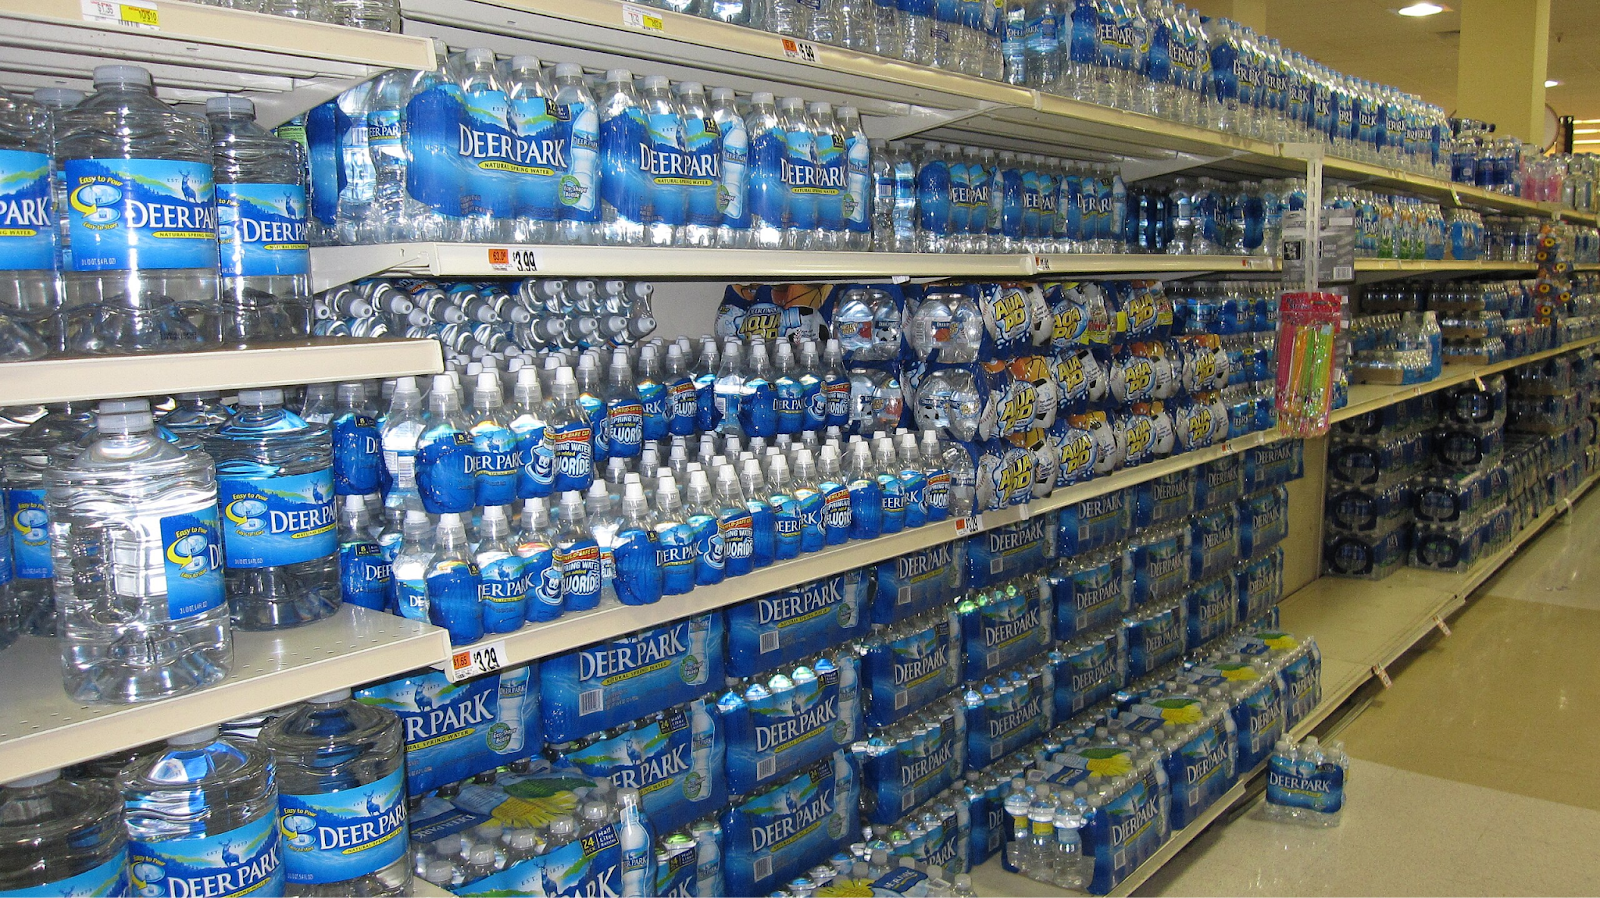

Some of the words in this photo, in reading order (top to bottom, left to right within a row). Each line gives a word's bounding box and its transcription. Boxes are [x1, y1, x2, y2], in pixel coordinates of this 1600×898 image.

[459, 123, 516, 163] DEER
[516, 140, 568, 172] PARK
[640, 142, 685, 179] DEER
[684, 150, 721, 182] PARK
[781, 156, 818, 187] DEER
[816, 165, 848, 191] PARK
[79, 177, 97, 189] Easy
[98, 176, 106, 185] to
[107, 177, 124, 188] Pour
[125, 199, 195, 231] DEER
[195, 203, 217, 234] PAR
[159, 231, 186, 240] NATURAL
[243, 217, 291, 247] DEER
[512, 251, 538, 272] $3.99
[233, 493, 248, 502] Easy
[269, 508, 323, 534] DEER
[758, 592, 806, 625] DEER
[804, 577, 842, 612] PARK
[454, 657, 469, 669] $1.65
[473, 647, 501, 673] $3.29
[579, 640, 634, 682] DEER
[633, 622, 687, 666] PARK
[428, 690, 495, 736] PARK
[756, 718, 803, 752] DEER
[801, 696, 837, 732] PARK
[423, 735, 447, 748] SPRING
[447, 729, 470, 742] WATER
[640, 743, 690, 788] PARK
[1270, 772, 1299, 789] DEER
[1300, 779, 1330, 794] PARK
[284, 808, 298, 816] Easy
[752, 816, 800, 853] DEER
[796, 791, 833, 829] PARK
[319, 822, 380, 850] DEER
[582, 837, 595, 849] 24
[598, 826, 613, 837] Half
[599, 833, 615, 844] Liter
[168, 873, 238, 898] DEER
[236, 842, 280, 889] PARK
